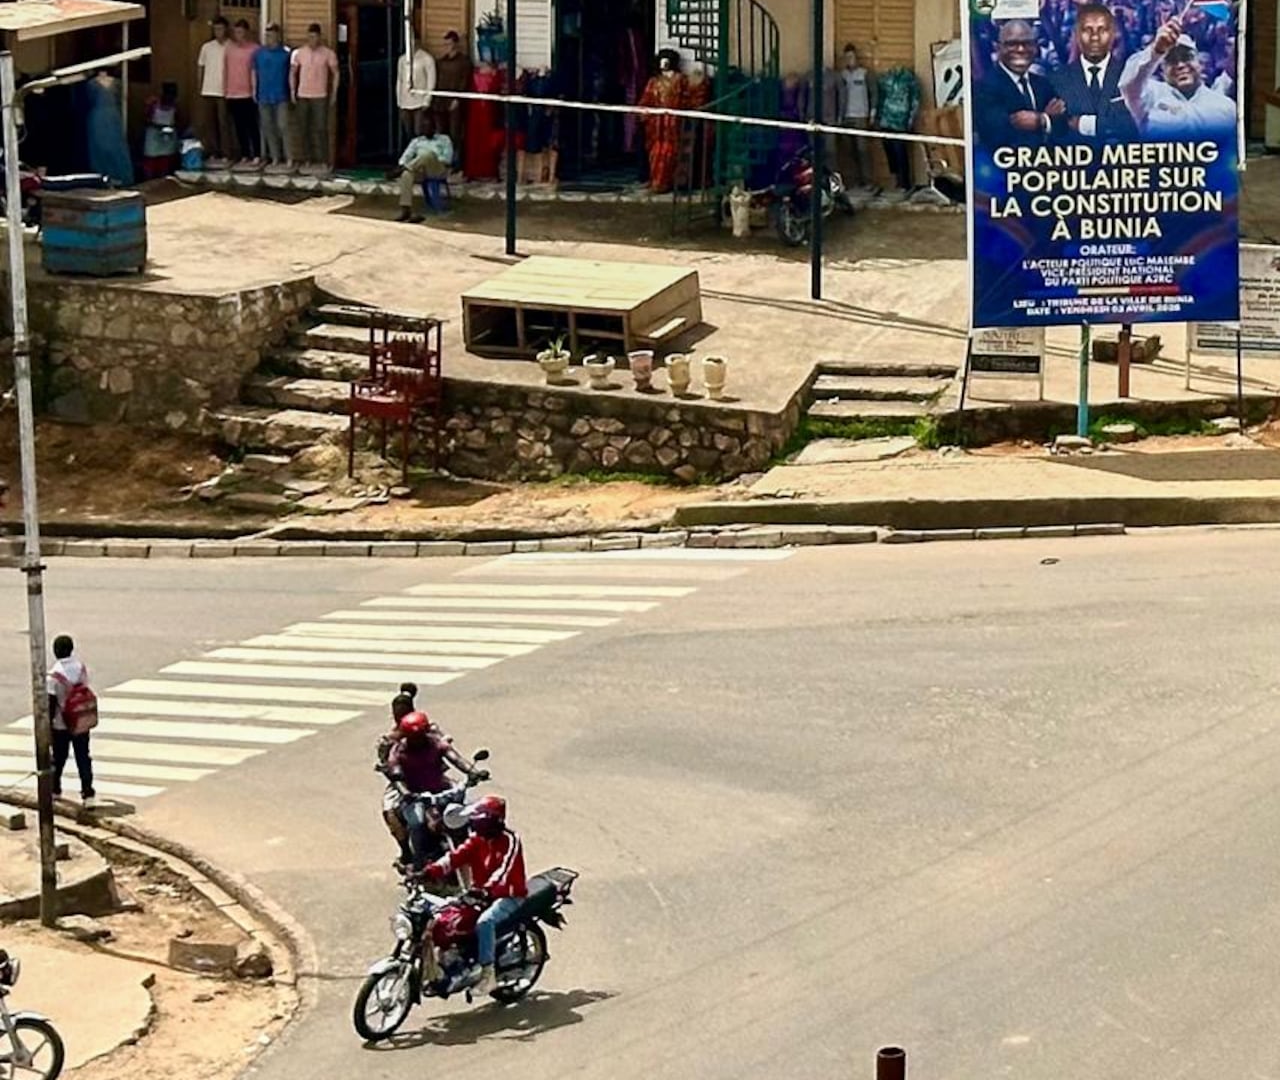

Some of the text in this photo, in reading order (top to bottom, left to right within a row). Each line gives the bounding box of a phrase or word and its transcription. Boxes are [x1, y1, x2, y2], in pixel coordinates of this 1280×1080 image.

[993, 141, 1219, 168] GRAND MEETING
[1007, 166, 1206, 193] POPULAIRE SUR
[990, 191, 1222, 218] LA CONSTITUTION
[1051, 214, 1163, 240] À BUNIA
[1071, 257, 1121, 269] POLITIQUE
[1122, 265, 1175, 275] NATIONAL
[1044, 276, 1060, 287] DU
[1061, 276, 1090, 286] PARTI
[1091, 275, 1142, 286] POLITIQUE
